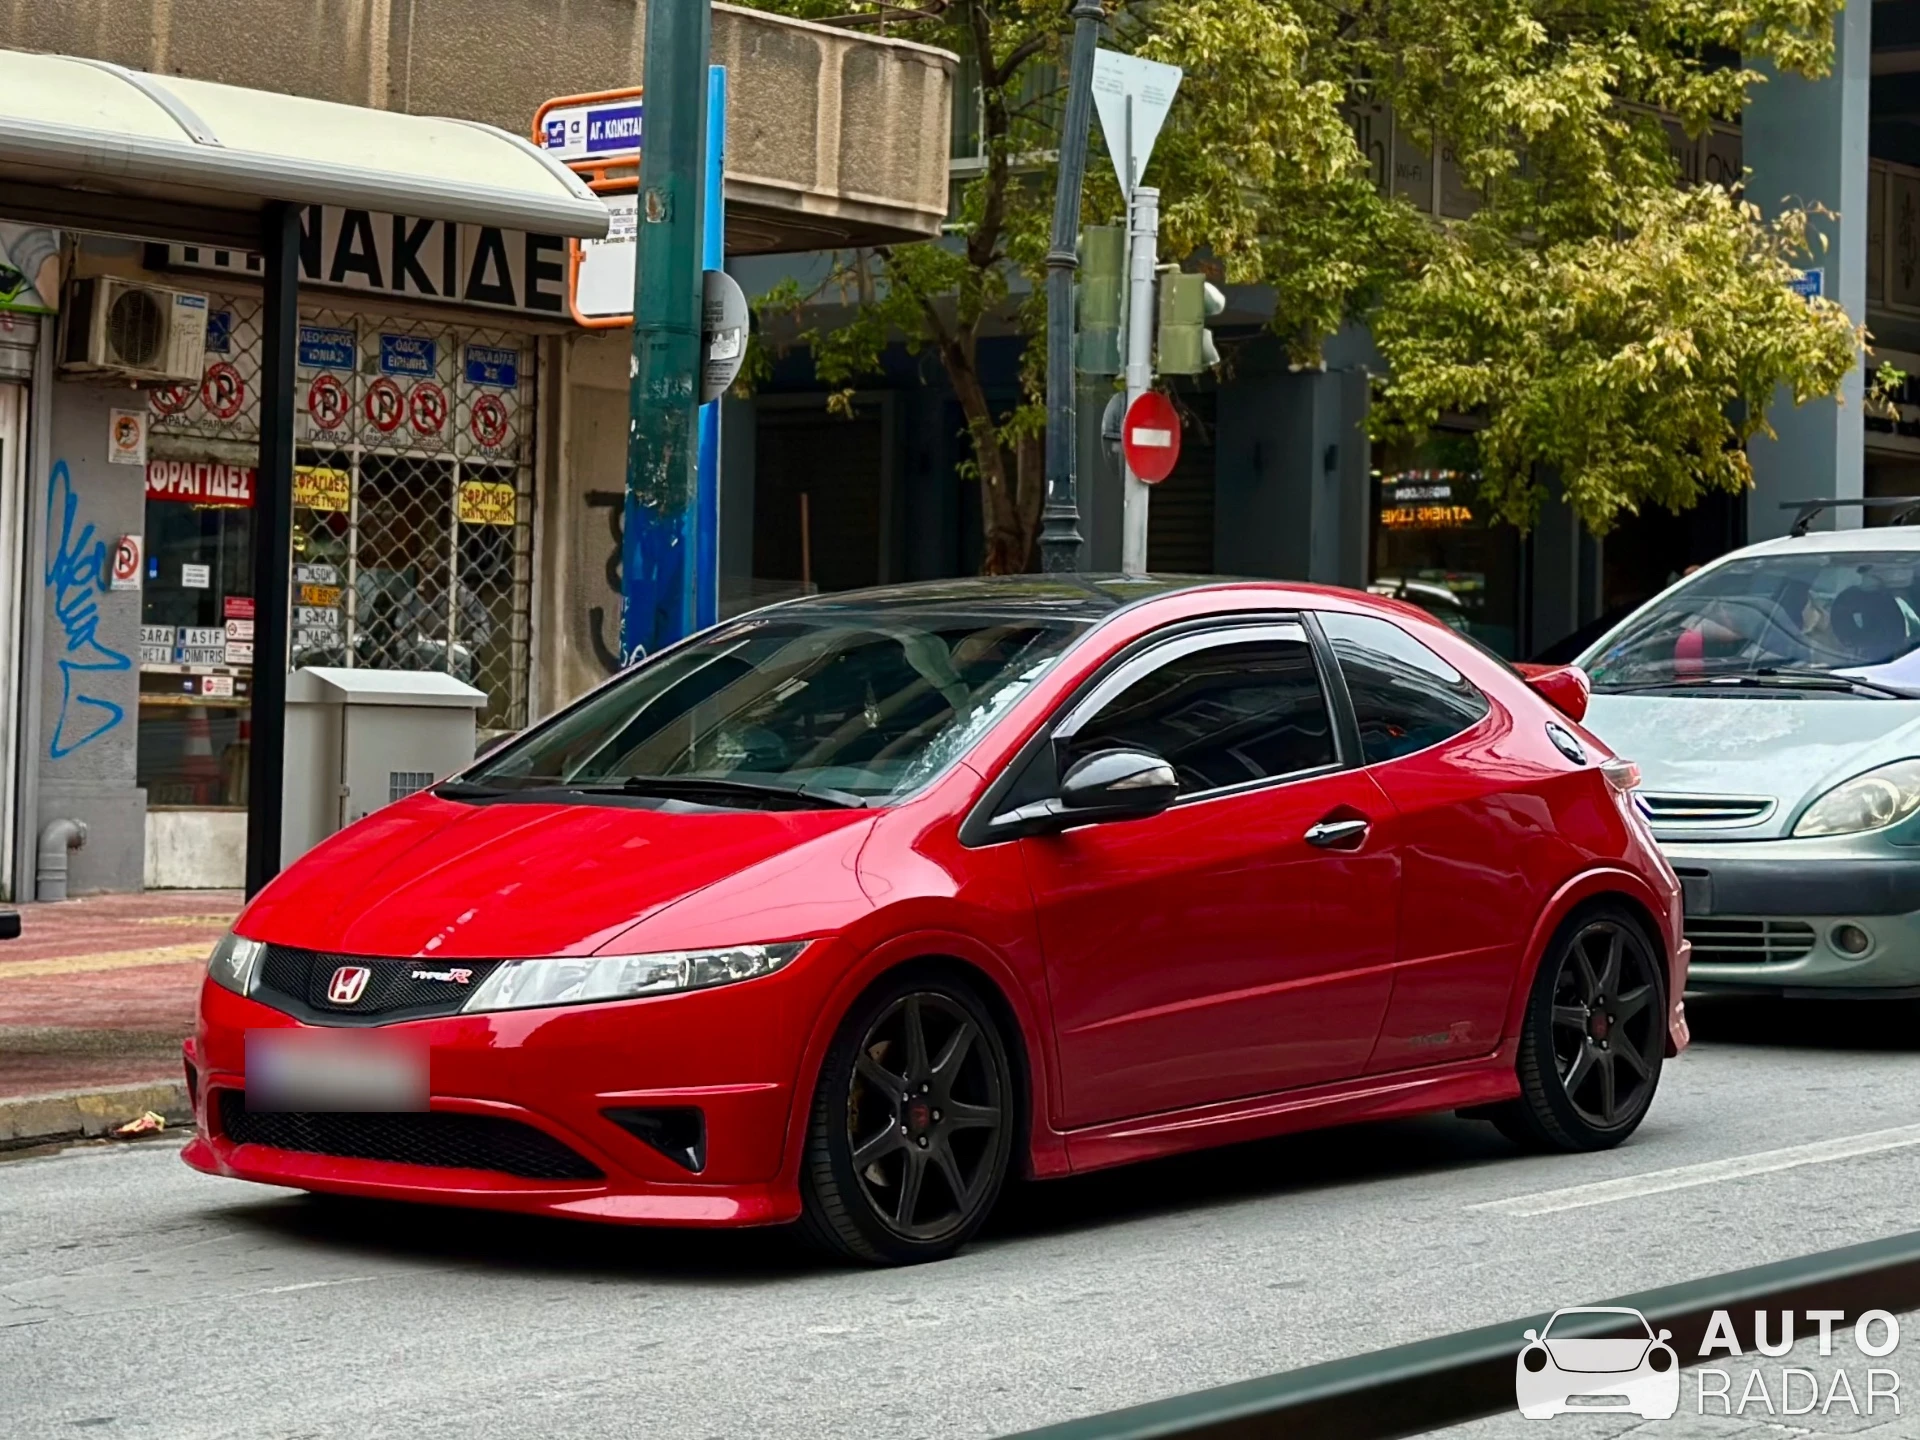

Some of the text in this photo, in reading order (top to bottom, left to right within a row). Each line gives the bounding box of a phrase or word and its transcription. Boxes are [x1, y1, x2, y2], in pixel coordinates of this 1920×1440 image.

[184, 204, 563, 312] ΝΑΚΙΔΕ
[305, 610, 334, 624] SARA
[140, 628, 170, 643] SARA
[184, 649, 223, 664] DIMITRIS
